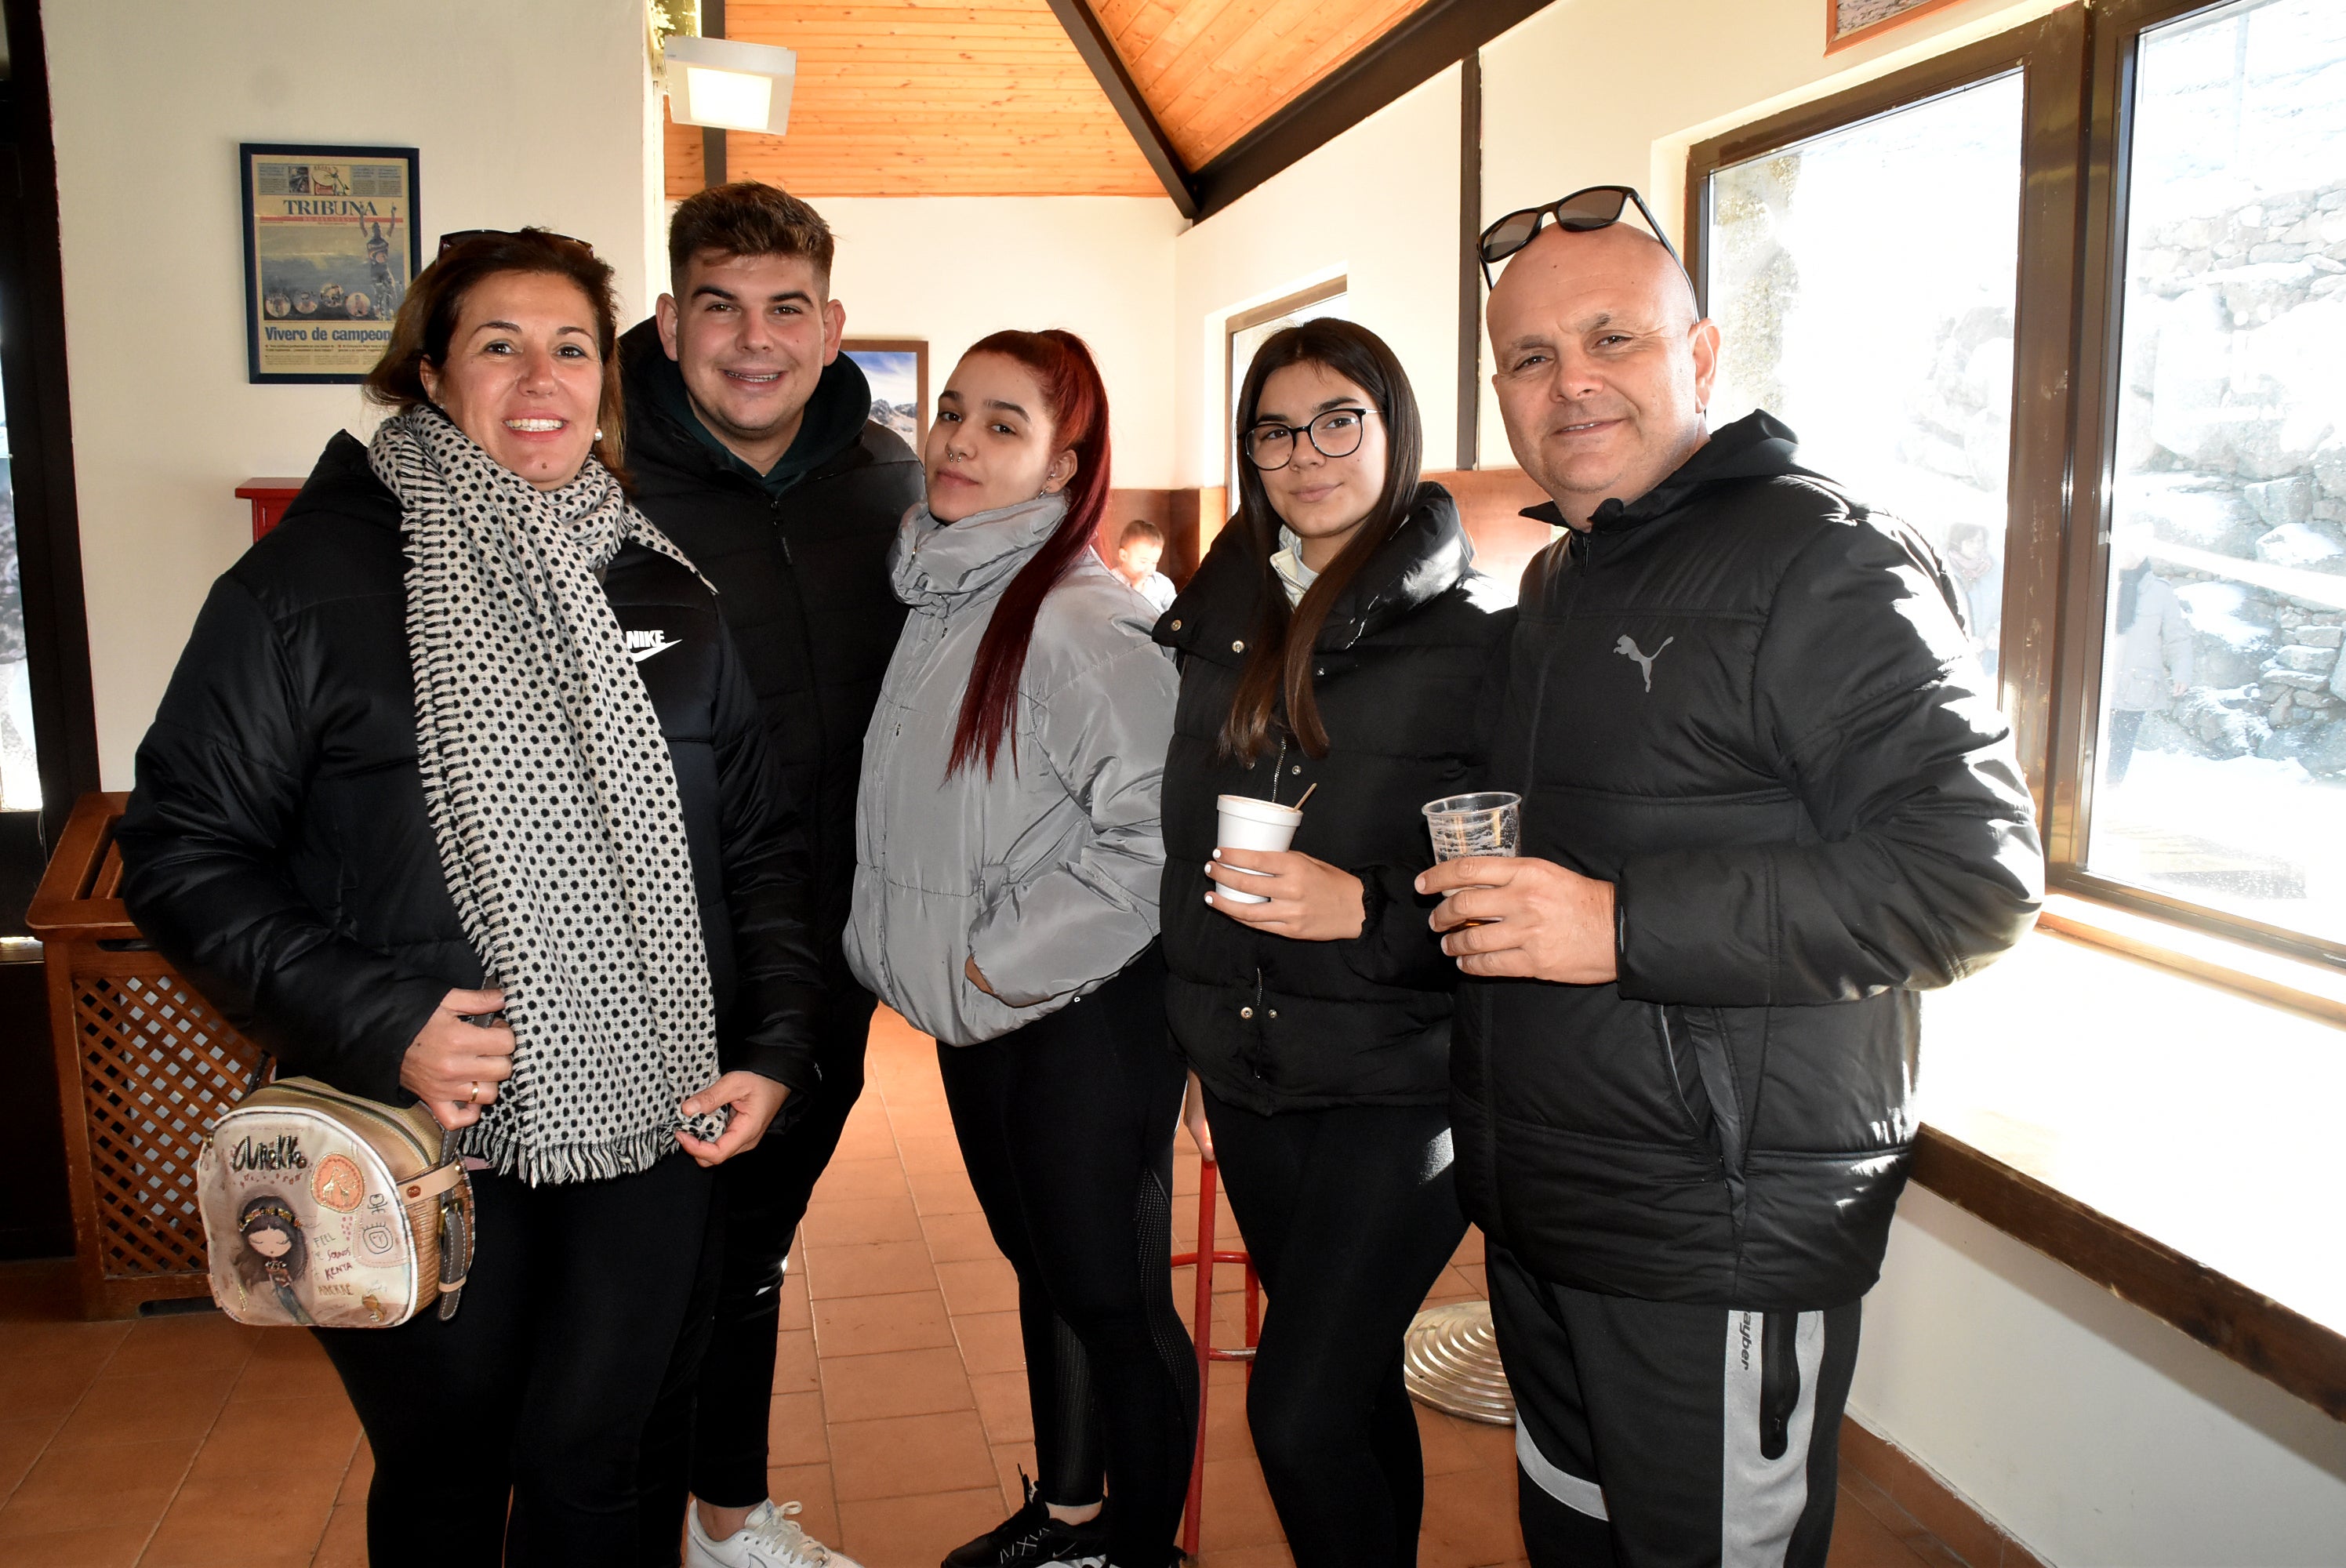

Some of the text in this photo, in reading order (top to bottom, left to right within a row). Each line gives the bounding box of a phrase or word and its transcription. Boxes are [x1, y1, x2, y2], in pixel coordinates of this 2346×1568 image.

[283, 199, 378, 216] TRIBUNA
[265, 326, 307, 340] Vivero
[311, 326, 328, 340] de
[626, 630, 665, 648] NIKE
[325, 1262, 353, 1281] KENYA
[1739, 1310, 1752, 1371] ayber
